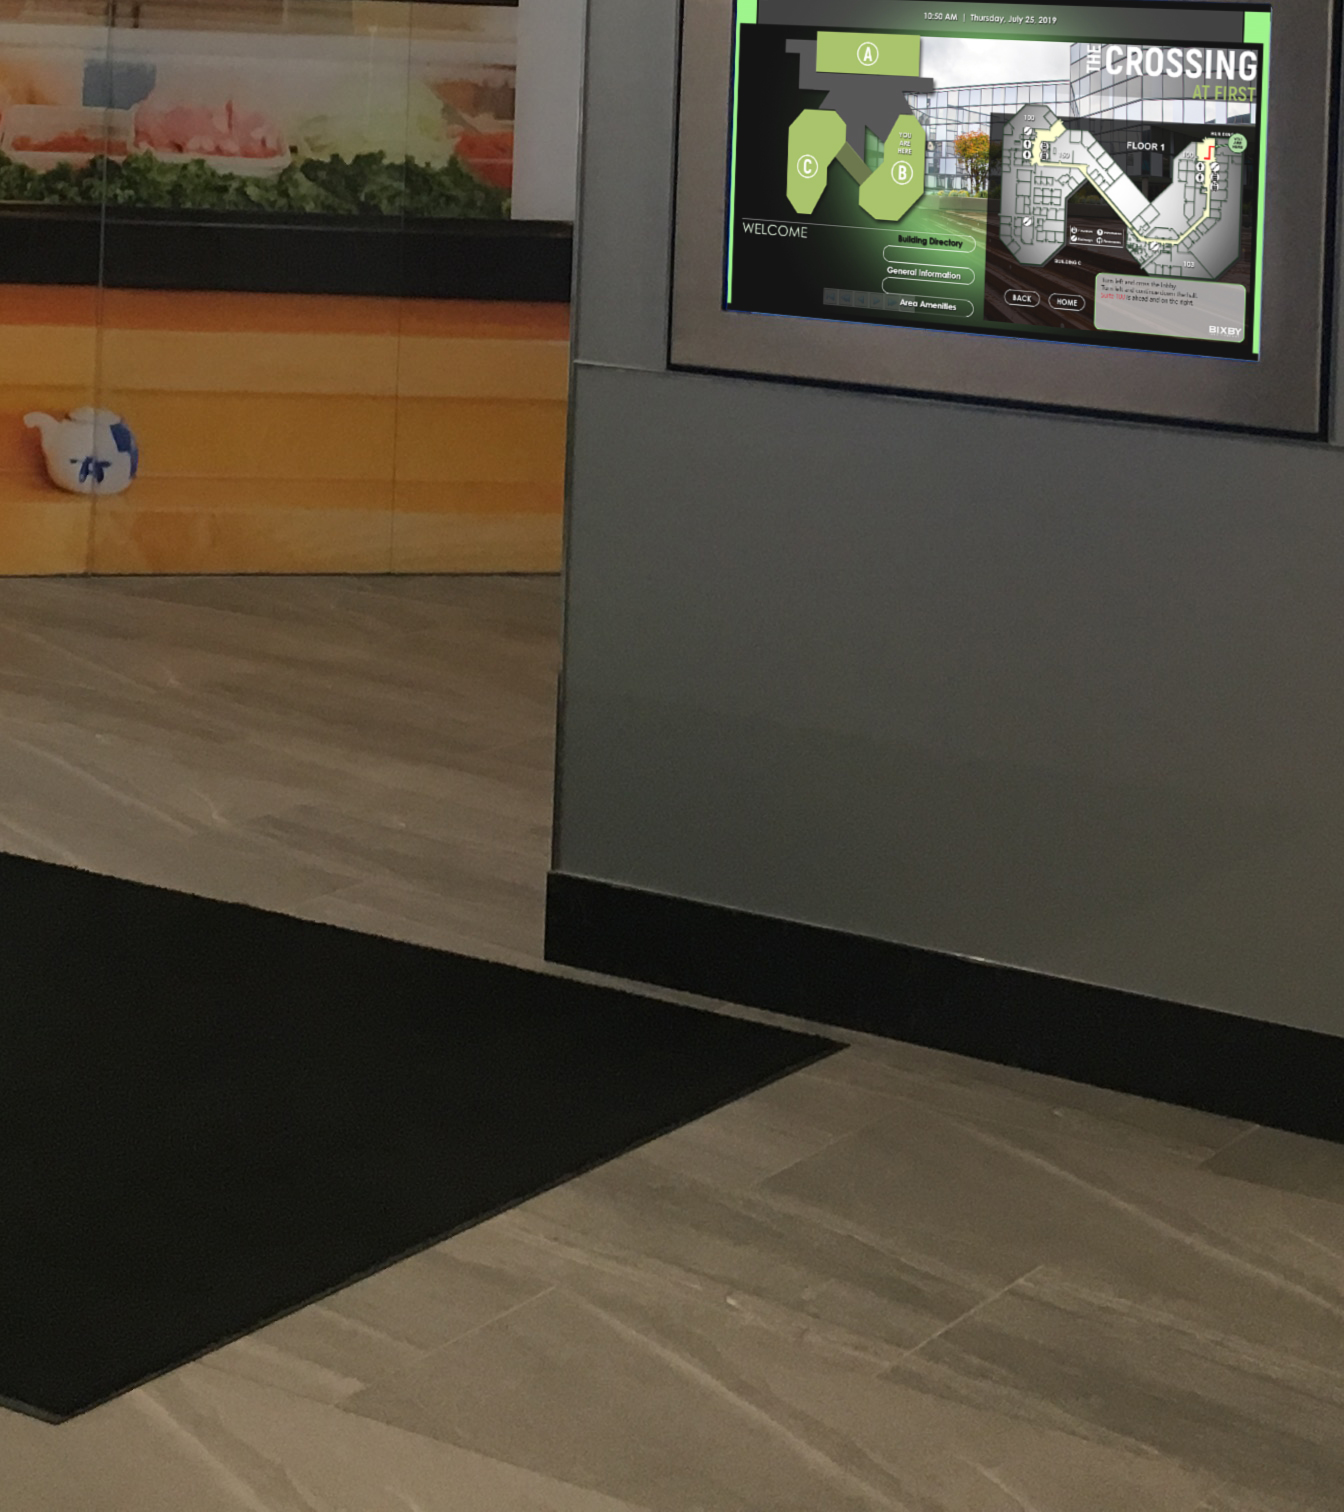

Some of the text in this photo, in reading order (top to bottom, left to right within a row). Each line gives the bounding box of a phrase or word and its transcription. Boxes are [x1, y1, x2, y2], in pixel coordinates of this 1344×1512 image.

[923, 12, 943, 20] 10:50
[945, 13, 958, 21] AM
[970, 14, 1006, 24] Thursday,
[1008, 15, 1023, 24] July
[1038, 16, 1058, 24] 2019
[863, 46, 873, 62] A
[1086, 44, 1101, 74] THE
[1105, 45, 1258, 82] CROSSING
[1192, 84, 1256, 102] AT FIRST
[1126, 141, 1165, 152] FLOOR 1
[803, 158, 812, 174] C
[898, 164, 907, 181] B
[742, 221, 808, 239] WELCOME
[898, 235, 963, 248] Building Directory
[887, 266, 961, 280] General Information
[899, 299, 956, 311] Area Amenities
[1012, 294, 1032, 302] BACK
[1056, 298, 1078, 306] HOME
[1208, 325, 1242, 336] BIXBY
